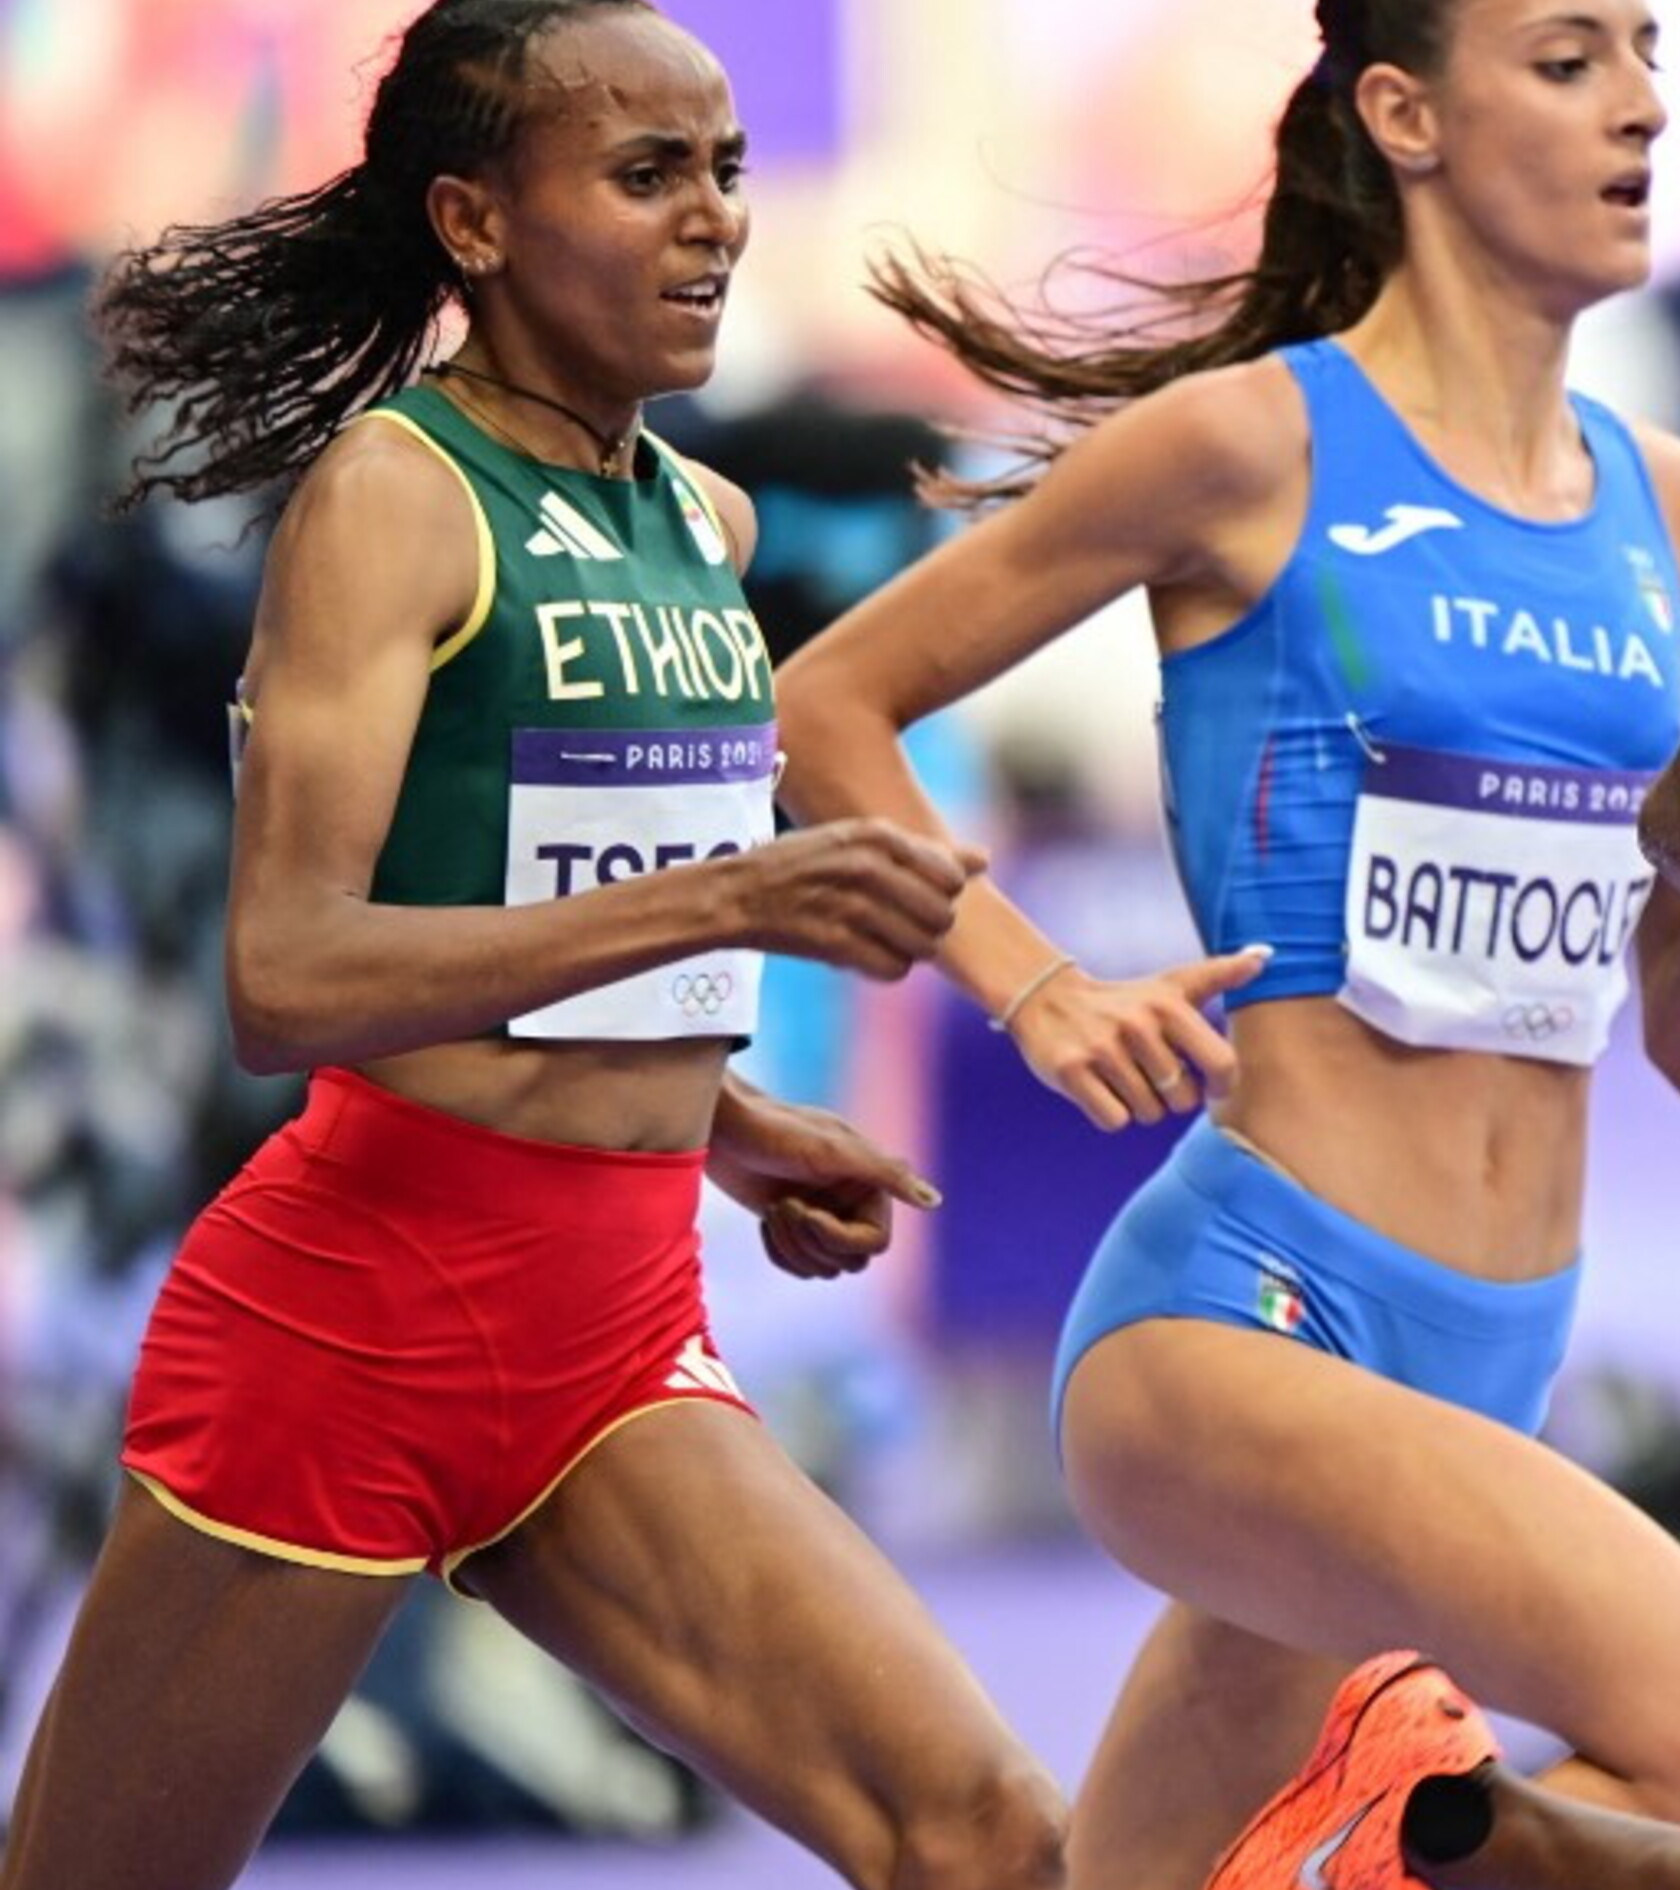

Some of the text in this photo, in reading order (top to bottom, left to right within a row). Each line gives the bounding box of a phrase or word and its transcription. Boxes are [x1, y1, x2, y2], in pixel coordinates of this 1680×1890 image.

[535, 600, 774, 702] ETHIOP
[1431, 594, 1665, 688] ITALIA
[1479, 770, 1581, 810] PARIS
